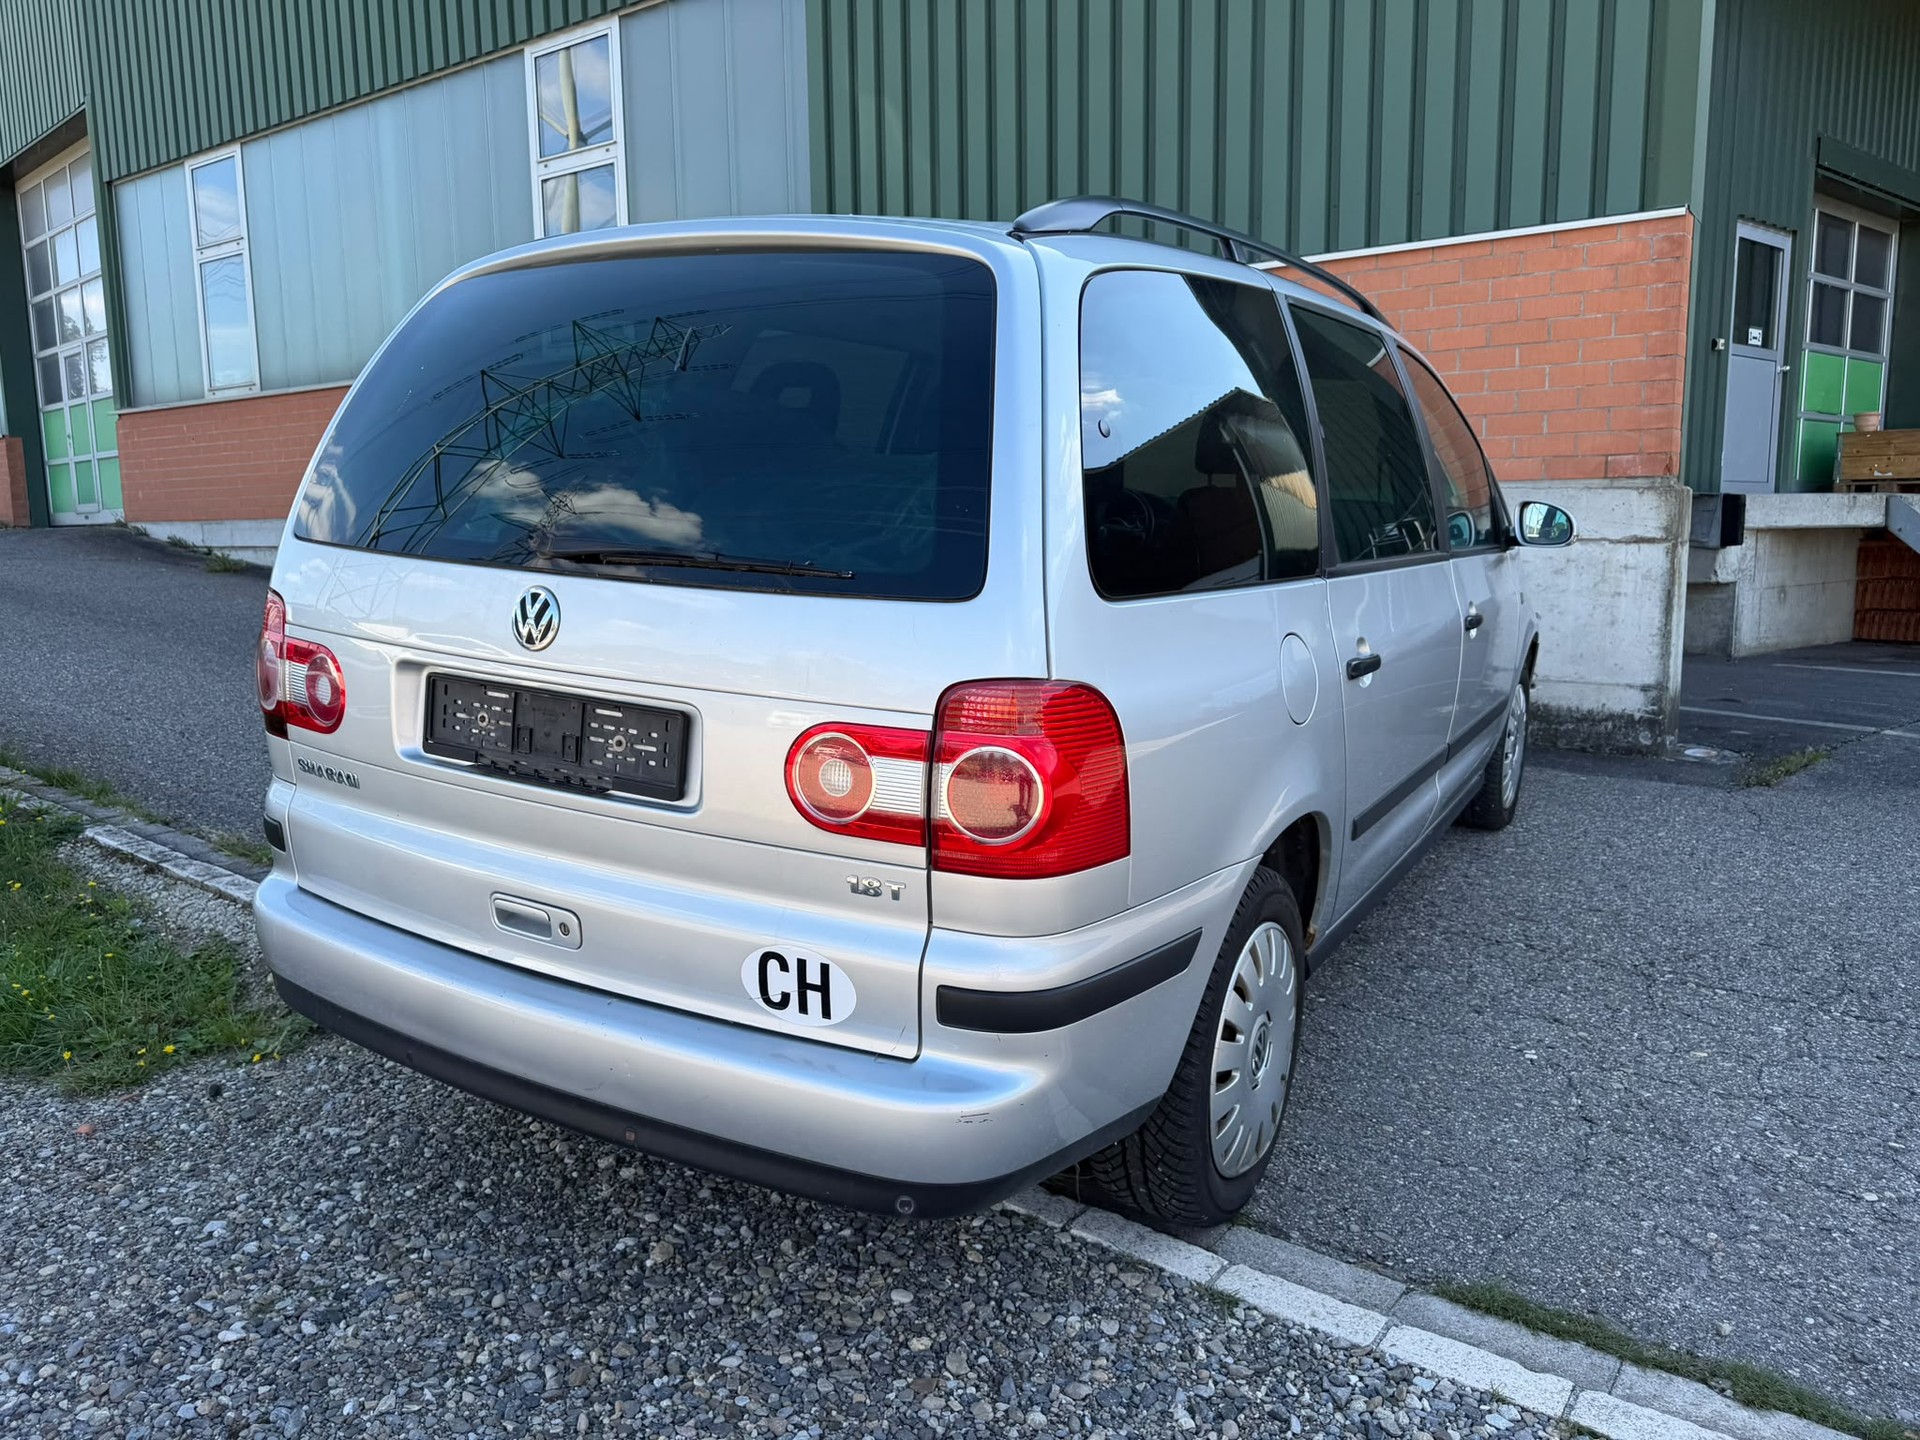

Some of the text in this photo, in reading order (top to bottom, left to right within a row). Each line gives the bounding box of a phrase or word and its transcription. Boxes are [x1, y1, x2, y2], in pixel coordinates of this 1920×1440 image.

[513, 587, 559, 649] VW
[297, 757, 361, 789] SHARAN
[758, 951, 832, 1020] CH
